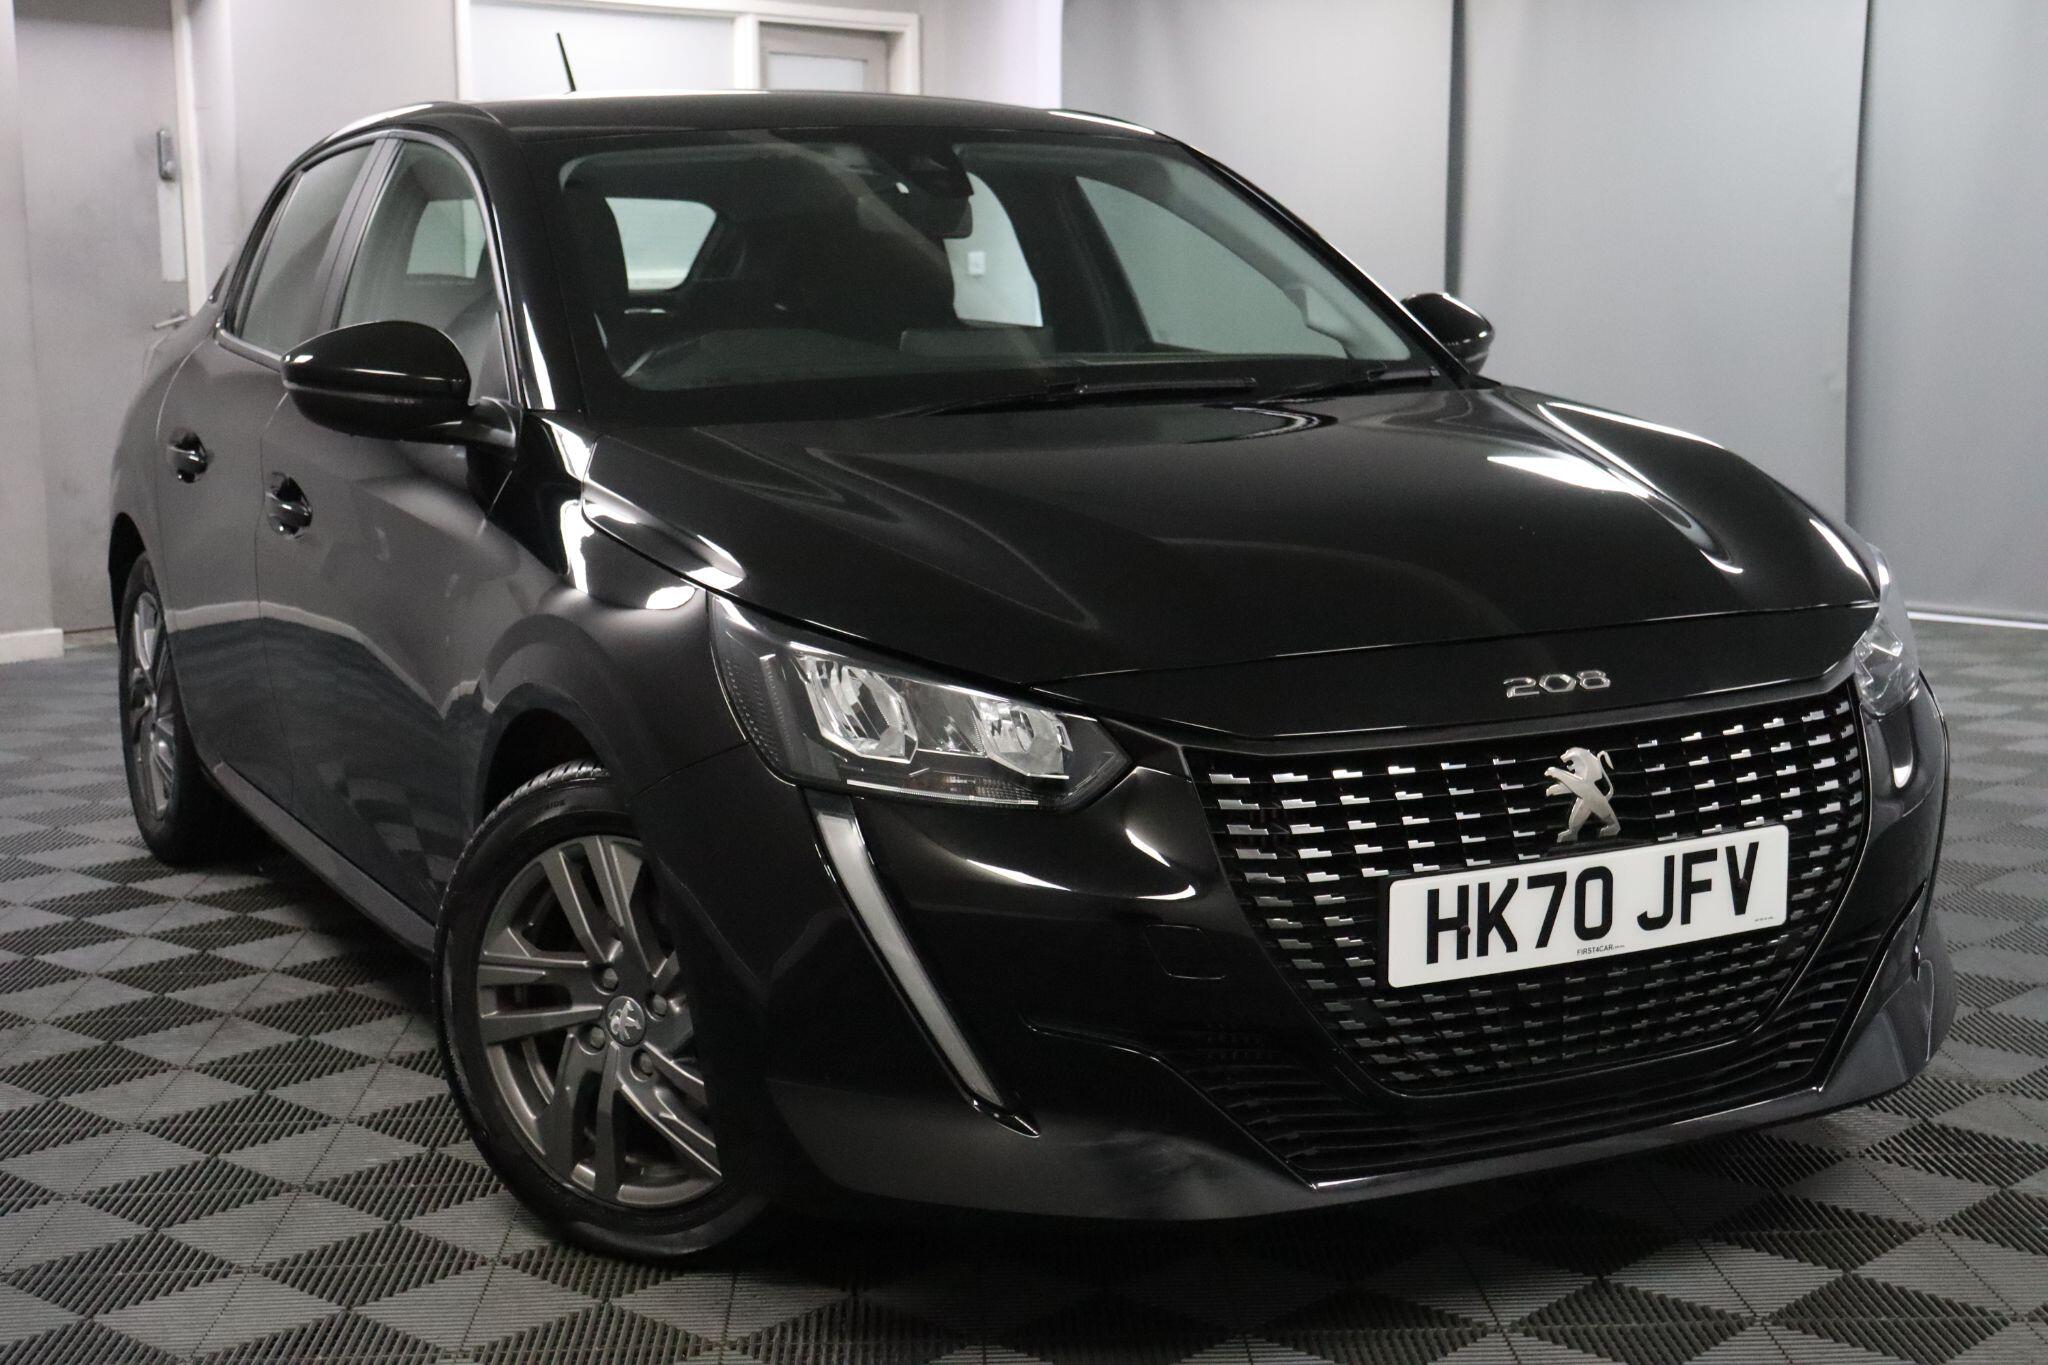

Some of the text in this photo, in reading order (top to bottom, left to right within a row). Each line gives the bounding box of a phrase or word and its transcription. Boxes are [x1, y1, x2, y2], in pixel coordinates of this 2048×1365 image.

[1503, 670, 1611, 698] 208
[1426, 841, 1760, 964] HK70 JFV
